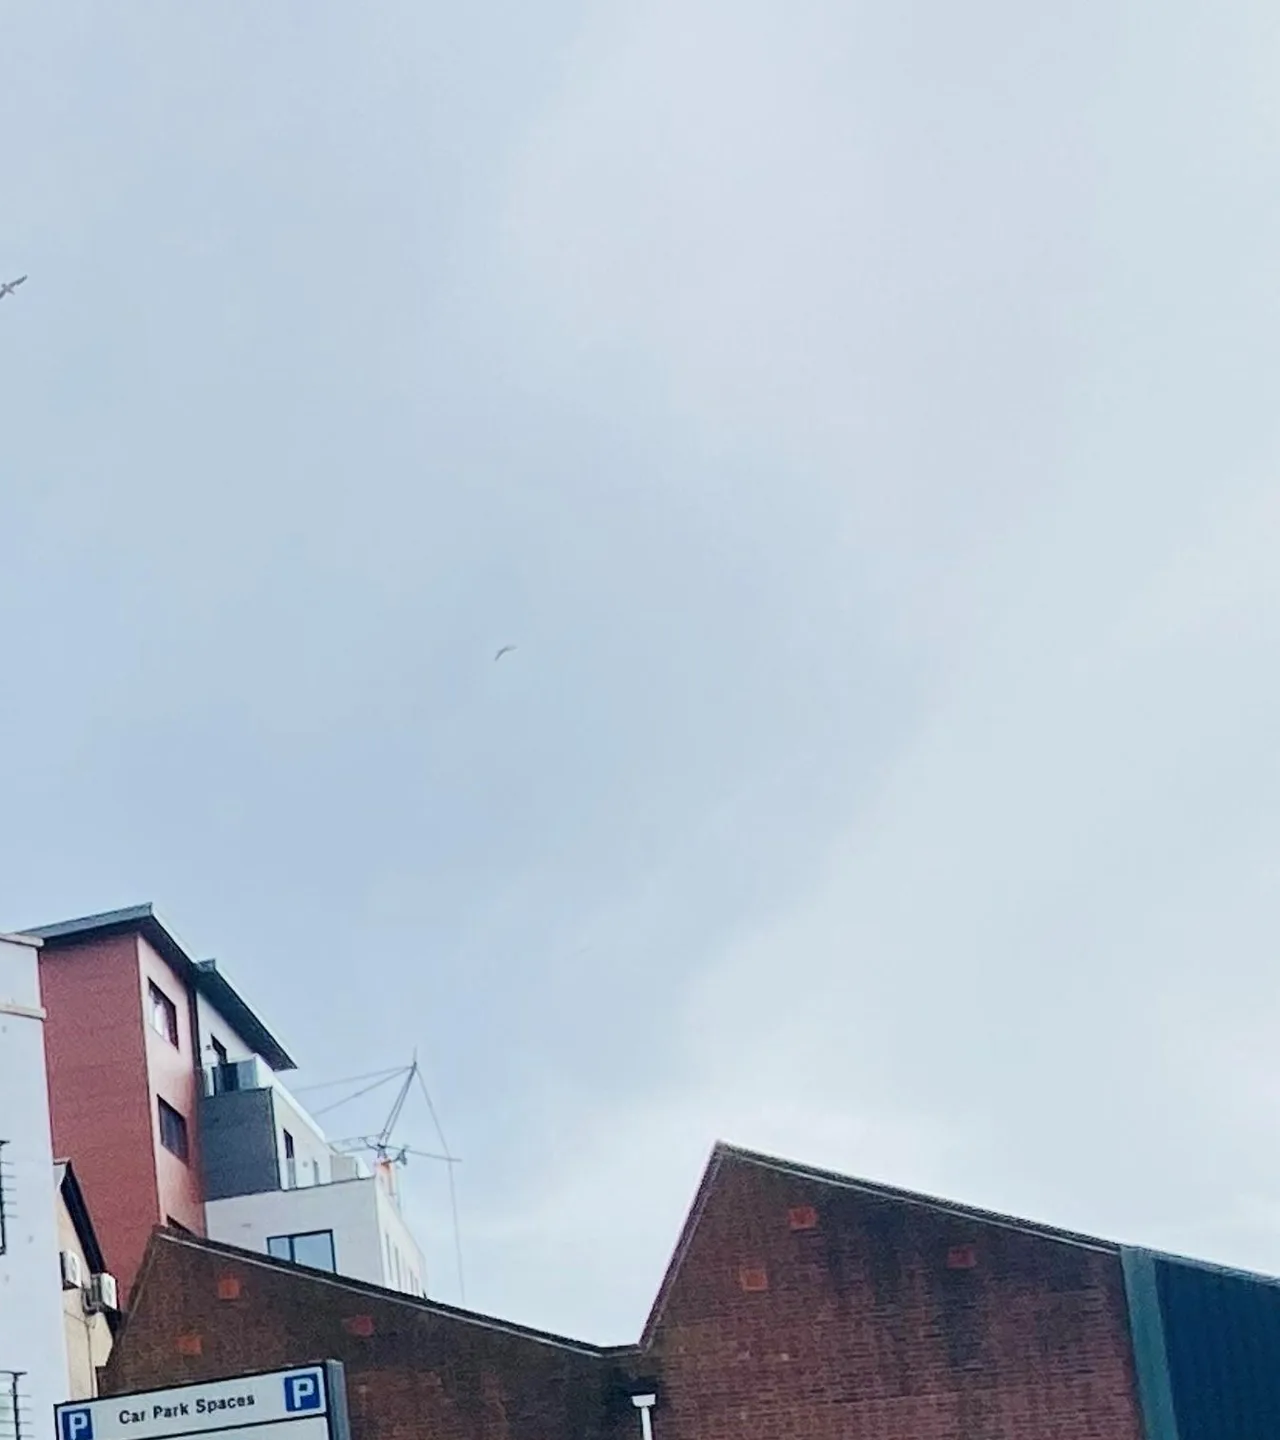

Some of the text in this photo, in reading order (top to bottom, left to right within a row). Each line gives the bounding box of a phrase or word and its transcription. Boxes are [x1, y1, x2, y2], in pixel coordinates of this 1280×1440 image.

[118, 1392, 256, 1425] Car Park Spaces
